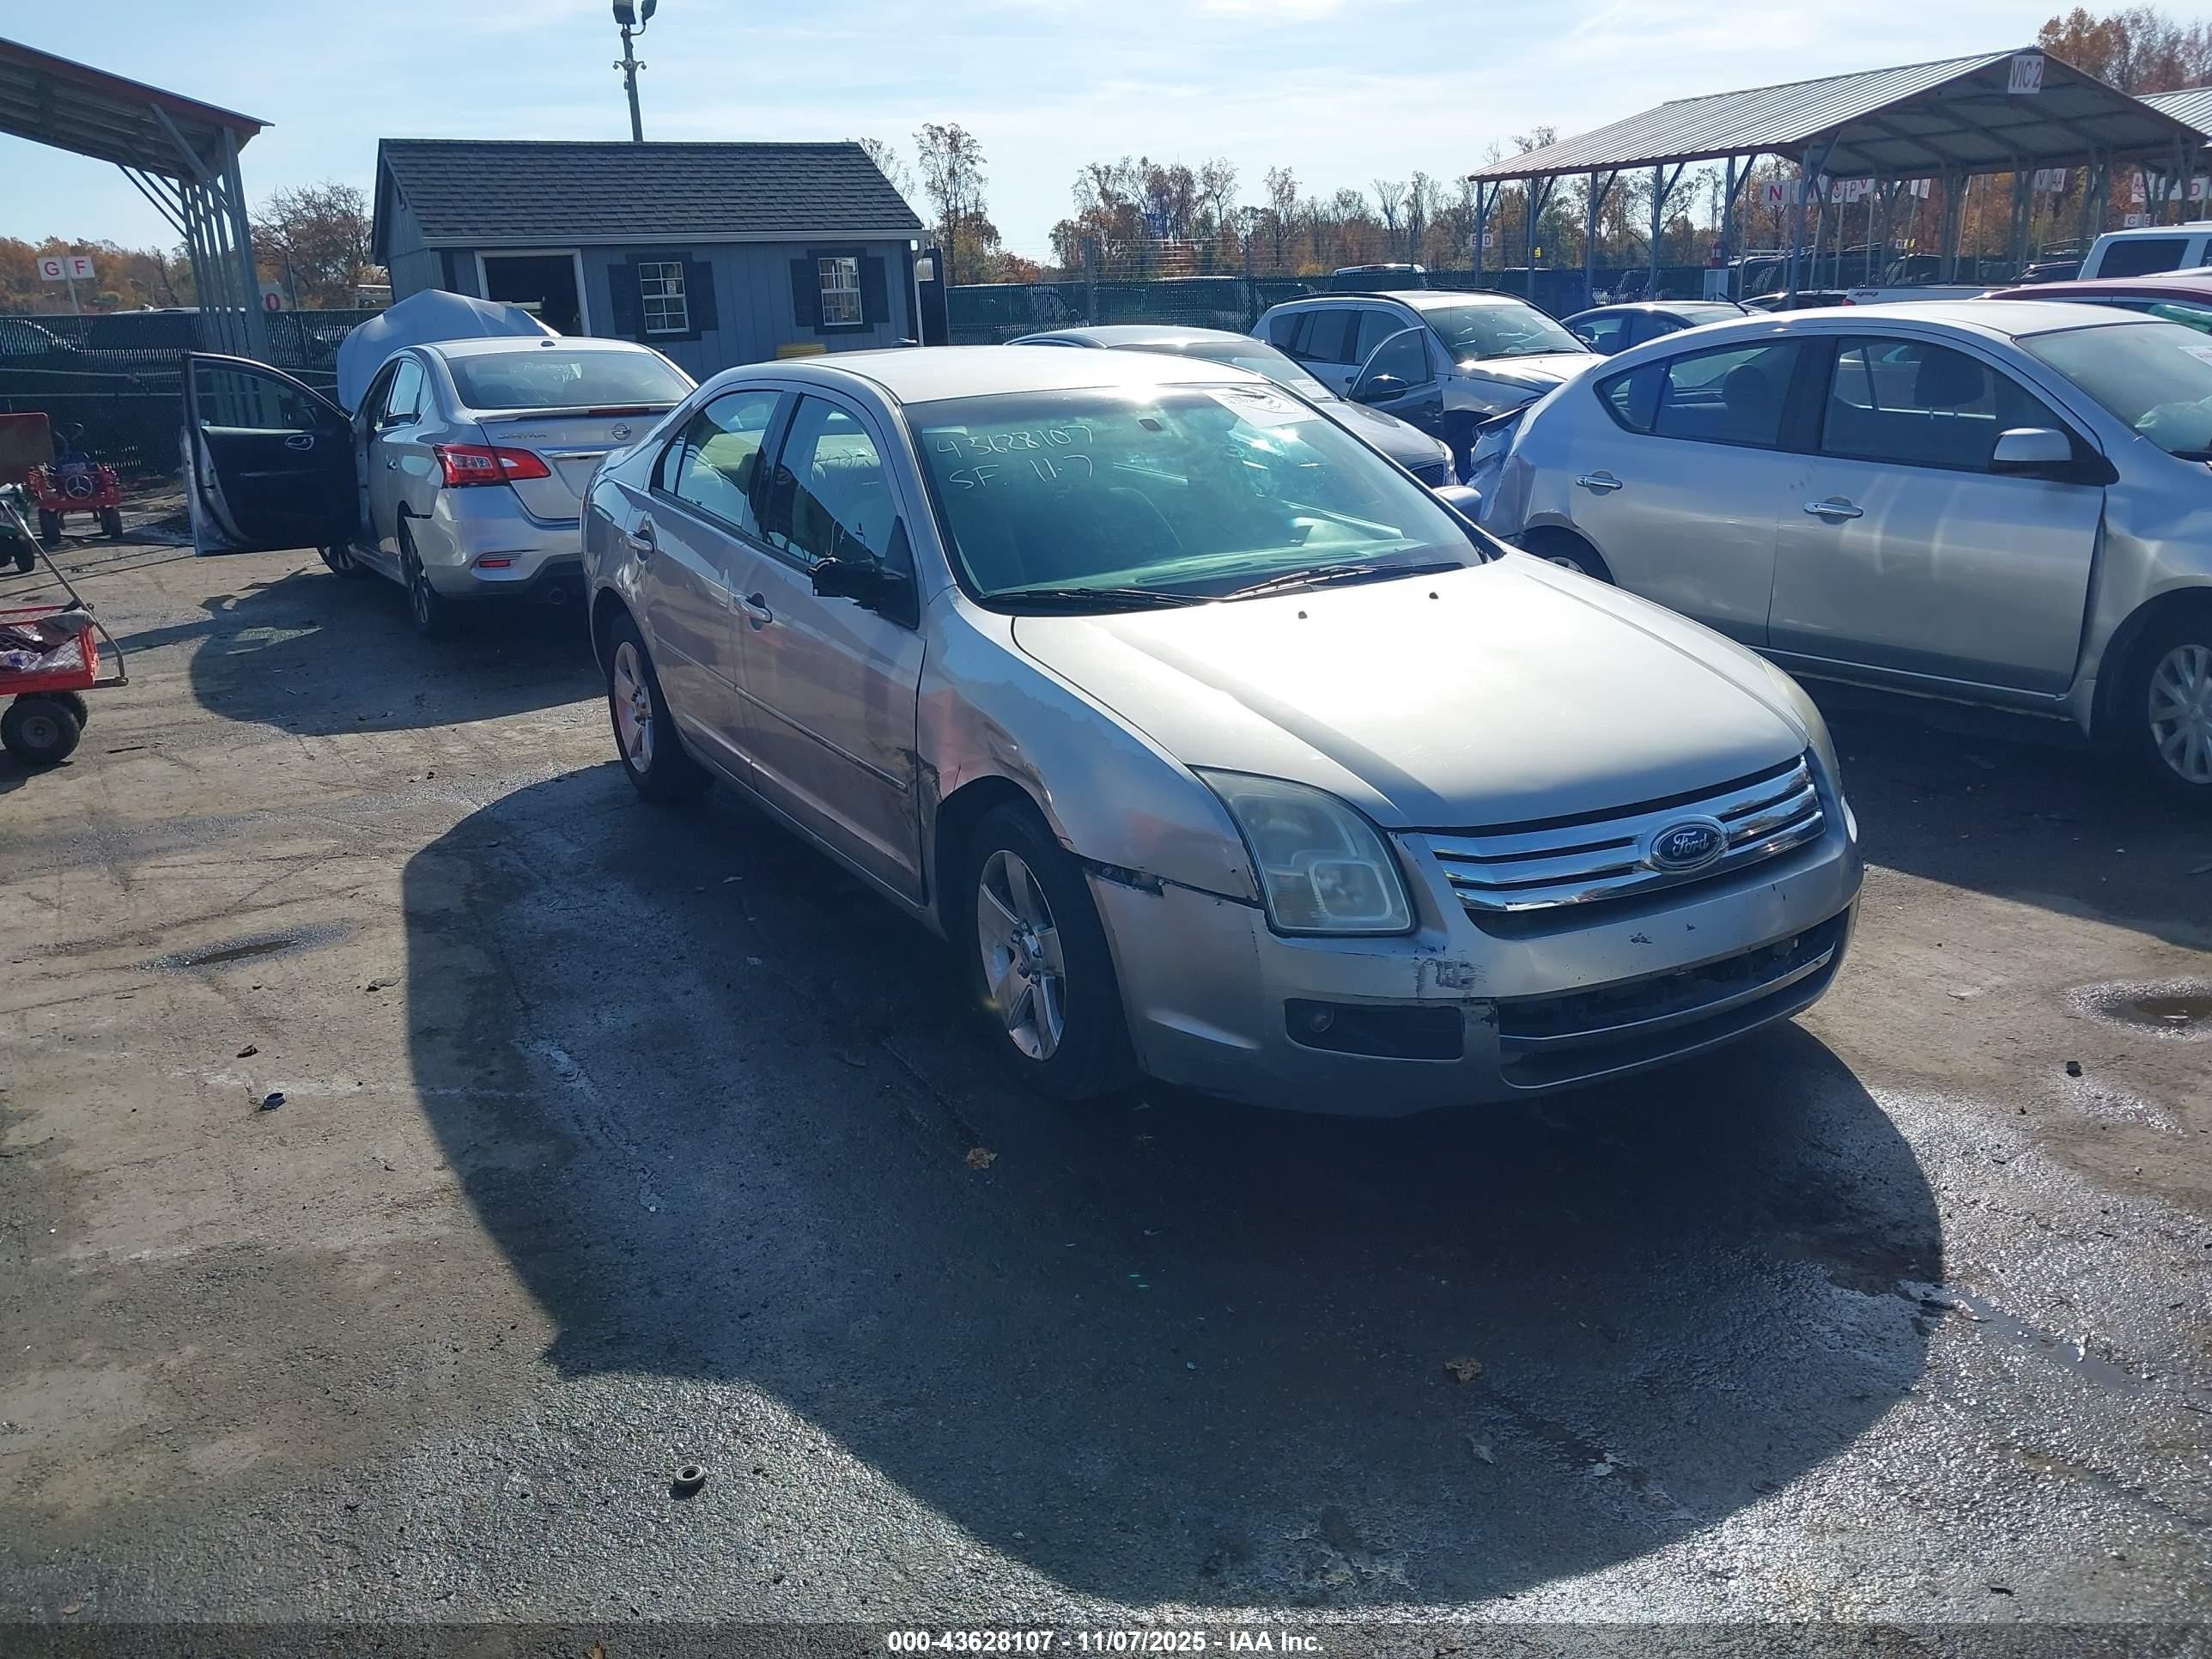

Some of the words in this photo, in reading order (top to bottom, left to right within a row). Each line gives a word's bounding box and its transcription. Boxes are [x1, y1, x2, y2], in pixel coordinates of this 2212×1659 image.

[2012, 61, 2033, 88] VIC
[2032, 61, 2042, 88] 2
[1769, 185, 1783, 201] N
[1485, 235, 1492, 246] D
[44, 261, 60, 276] G
[74, 260, 85, 274] F
[936, 425, 1093, 459] 43628107
[1672, 830, 1710, 857] Ford
